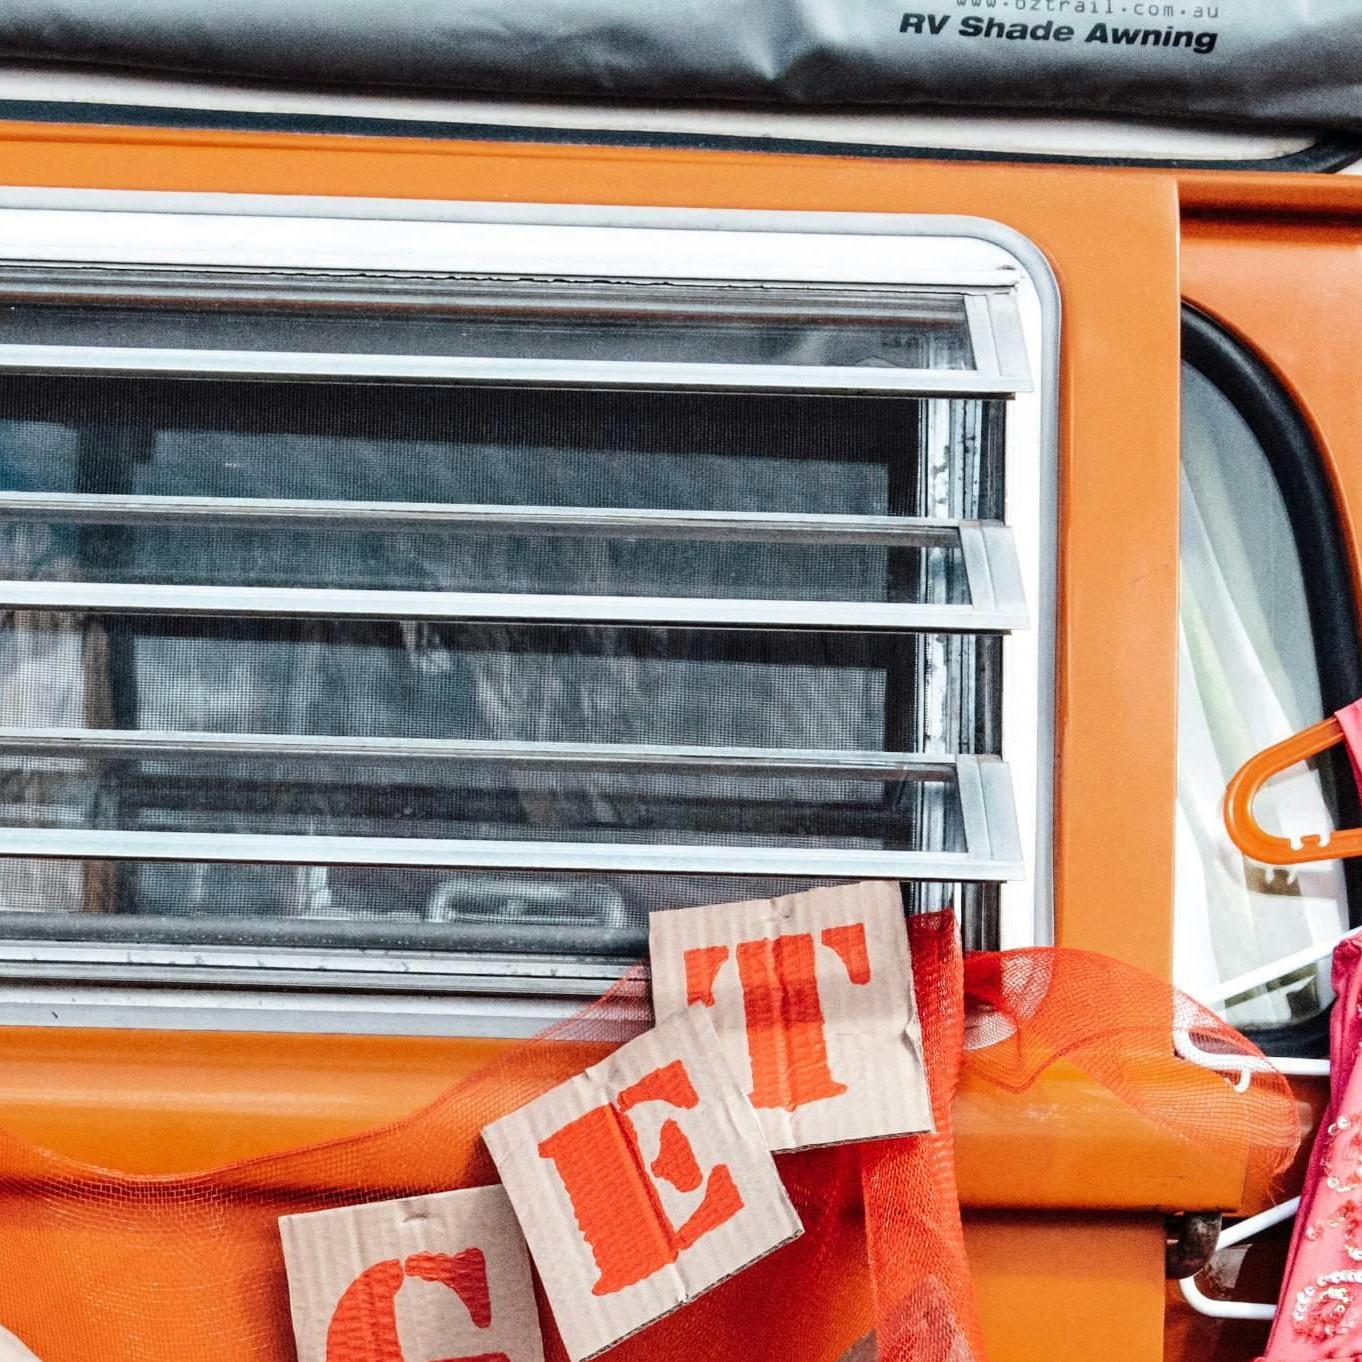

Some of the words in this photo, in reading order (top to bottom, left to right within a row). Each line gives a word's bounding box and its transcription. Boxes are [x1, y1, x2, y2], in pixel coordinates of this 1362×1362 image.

[899, 12, 951, 35] RV
[958, 15, 1075, 42] Shade
[1084, 22, 1218, 54] Awning
